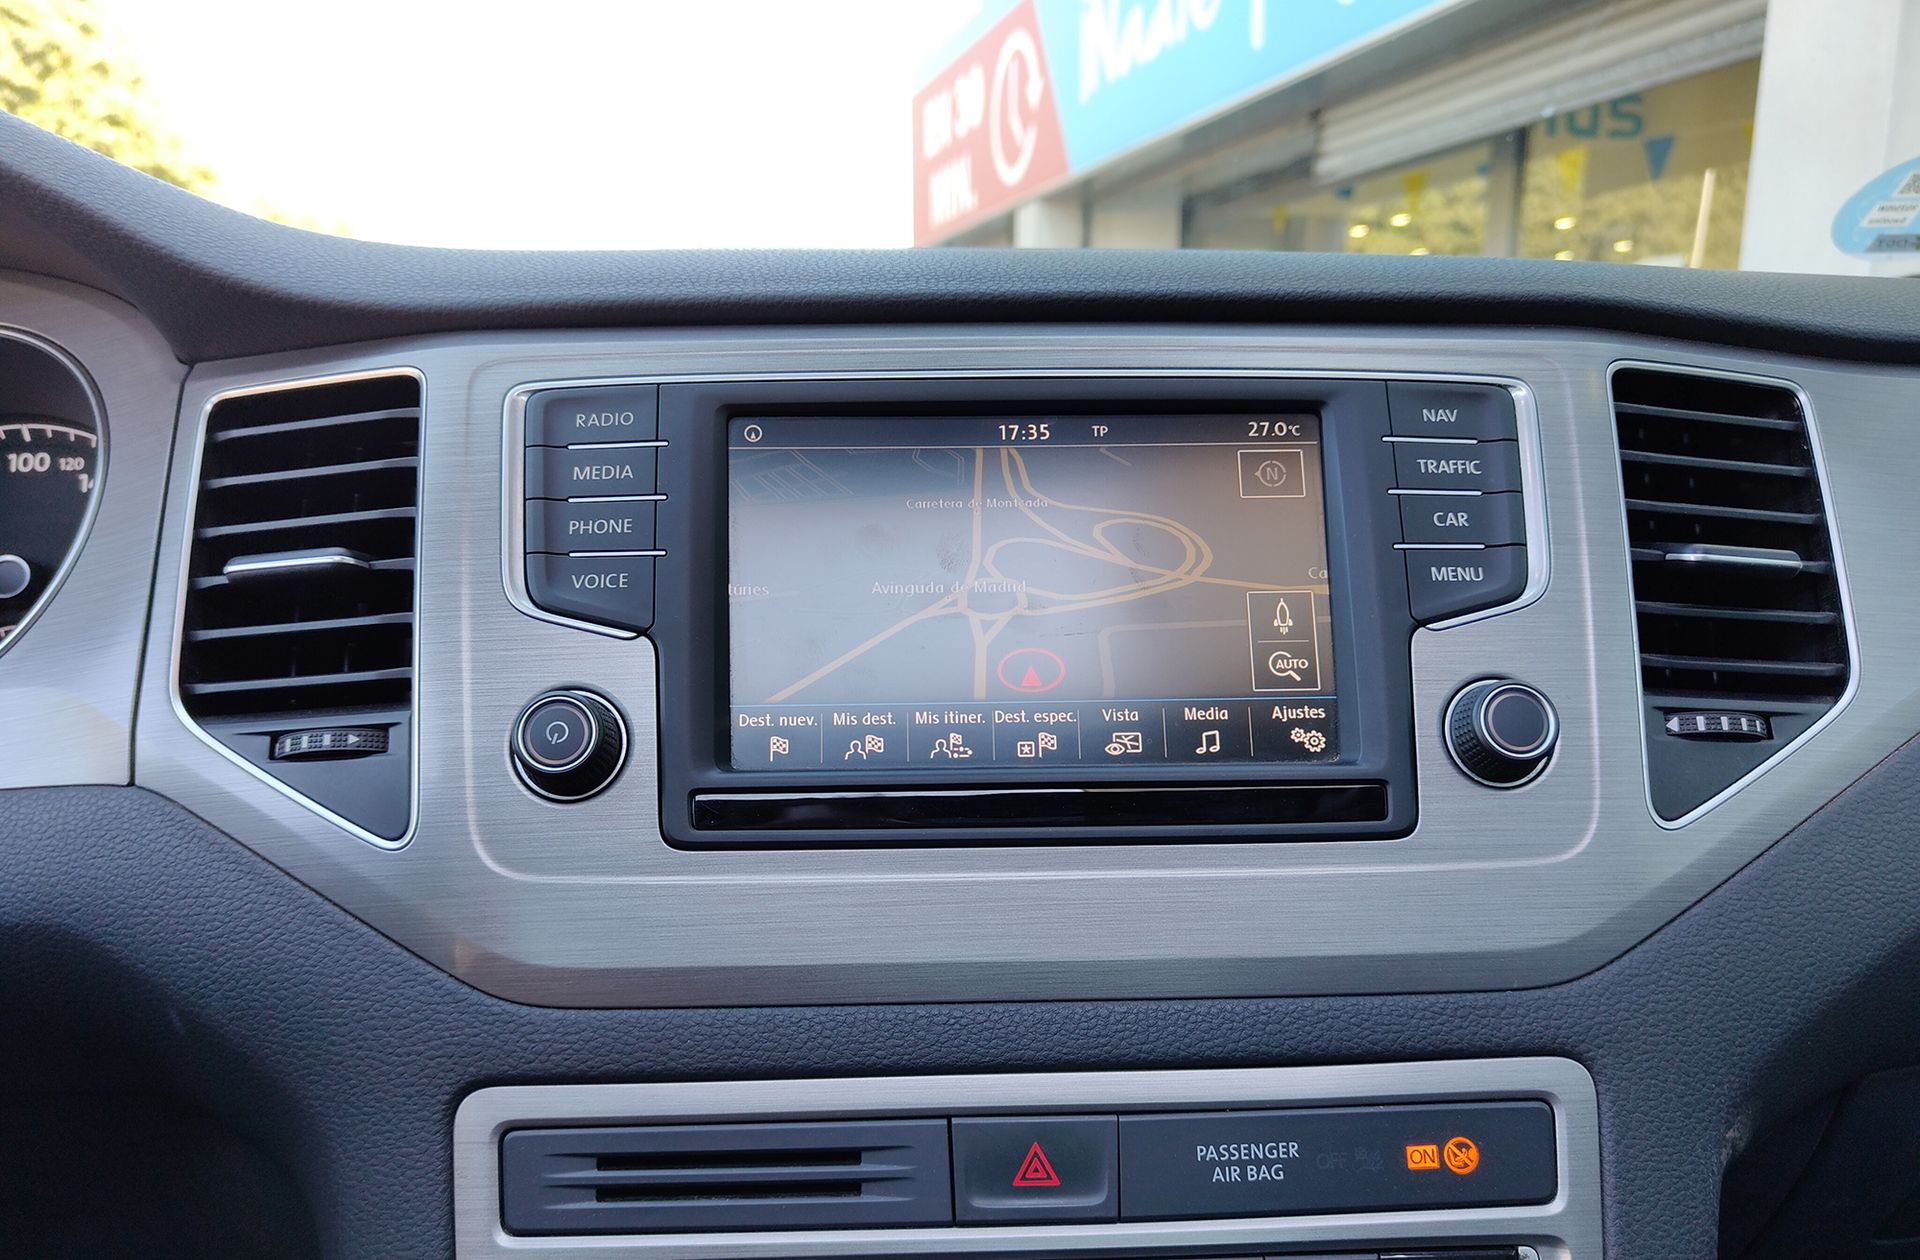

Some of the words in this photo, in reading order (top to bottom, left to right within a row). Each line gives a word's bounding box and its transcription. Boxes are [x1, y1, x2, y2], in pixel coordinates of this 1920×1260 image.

[575, 411, 635, 428] RADIO
[1422, 408, 1458, 423] NAV
[998, 423, 1050, 441] 17:35
[1091, 425, 1109, 437] TP
[1248, 421, 1301, 437] 27.0°C
[7, 452, 51, 473] 100
[58, 456, 86, 471] 120
[1416, 459, 1482, 475] TRAFFIC
[573, 464, 634, 480] MEDIA
[1266, 466, 1279, 481] N
[78, 473, 94, 493] 1
[906, 498, 963, 510] Carretera
[568, 518, 633, 535] PHONE
[1433, 512, 1470, 527] CAR
[571, 573, 629, 589] VOICE
[1430, 566, 1484, 582] MENU
[871, 580, 944, 597] Avinguda
[974, 580, 1027, 594] Madrid
[1275, 658, 1309, 670] AUTO
[738, 713, 775, 728] Dest.
[779, 714, 818, 727] nuev.
[832, 711, 858, 726] Mis
[862, 711, 897, 726] dest.
[914, 711, 940, 725] Mis
[944, 709, 986, 725] itiner.
[994, 709, 1029, 724] Dest.
[1033, 710, 1077, 725] espec.
[1101, 708, 1139, 722] Vista
[1184, 706, 1229, 721] Media
[1271, 704, 1326, 723] Ajustes
[1196, 1141, 1300, 1162] PASSENGER
[1409, 1148, 1436, 1166] ON
[1212, 1165, 1242, 1183] AIR
[1246, 1164, 1285, 1181] BAG
